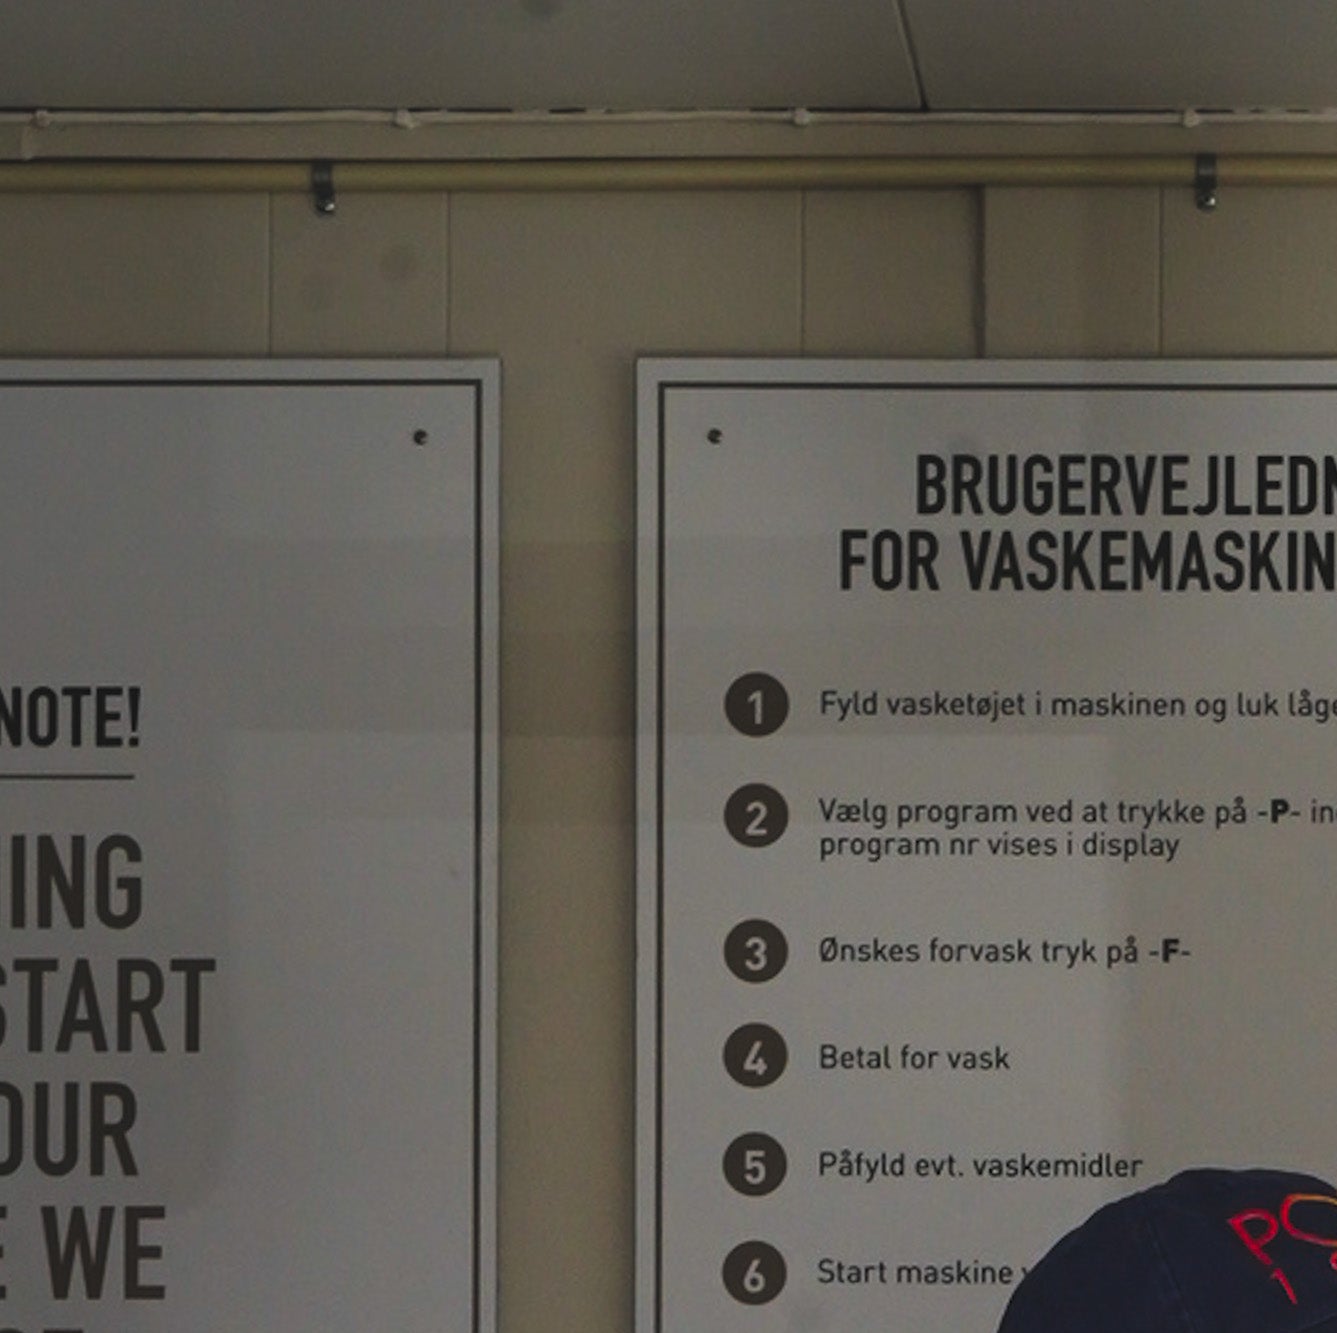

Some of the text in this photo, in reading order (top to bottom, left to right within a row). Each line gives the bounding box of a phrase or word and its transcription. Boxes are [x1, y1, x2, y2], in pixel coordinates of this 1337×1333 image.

[840, 528, 940, 592] FOR
[747, 690, 763, 725] 1
[820, 689, 878, 722] Fyld
[886, 690, 1026, 723] vasketøjet
[1035, 690, 1042, 716] i
[1051, 691, 1186, 717] maskinen
[1194, 697, 1227, 724] og
[1237, 691, 1279, 717] luk
[745, 801, 768, 836] 2
[818, 797, 888, 830] Vælg
[897, 804, 1018, 831] program
[1025, 798, 1073, 824] ved
[1081, 801, 1109, 824] at
[1117, 798, 1206, 830] trykke
[1215, 795, 1247, 830] på
[1257, 798, 1301, 824] -P-
[820, 831, 1181, 863] program nr vises i display
[745, 934, 1191, 971] 3 Ønskes forvask tryk på -F-
[0, 957, 217, 1054] TART
[743, 1040, 1011, 1076] 4 Betal for vask
[745, 1148, 1144, 1185] 5 Påfyld evt. vaskemidler
[40, 1205, 166, 1301] WE
[743, 1259, 765, 1293] 6
[817, 1257, 887, 1285] Start
[896, 1259, 1014, 1285] maskine
